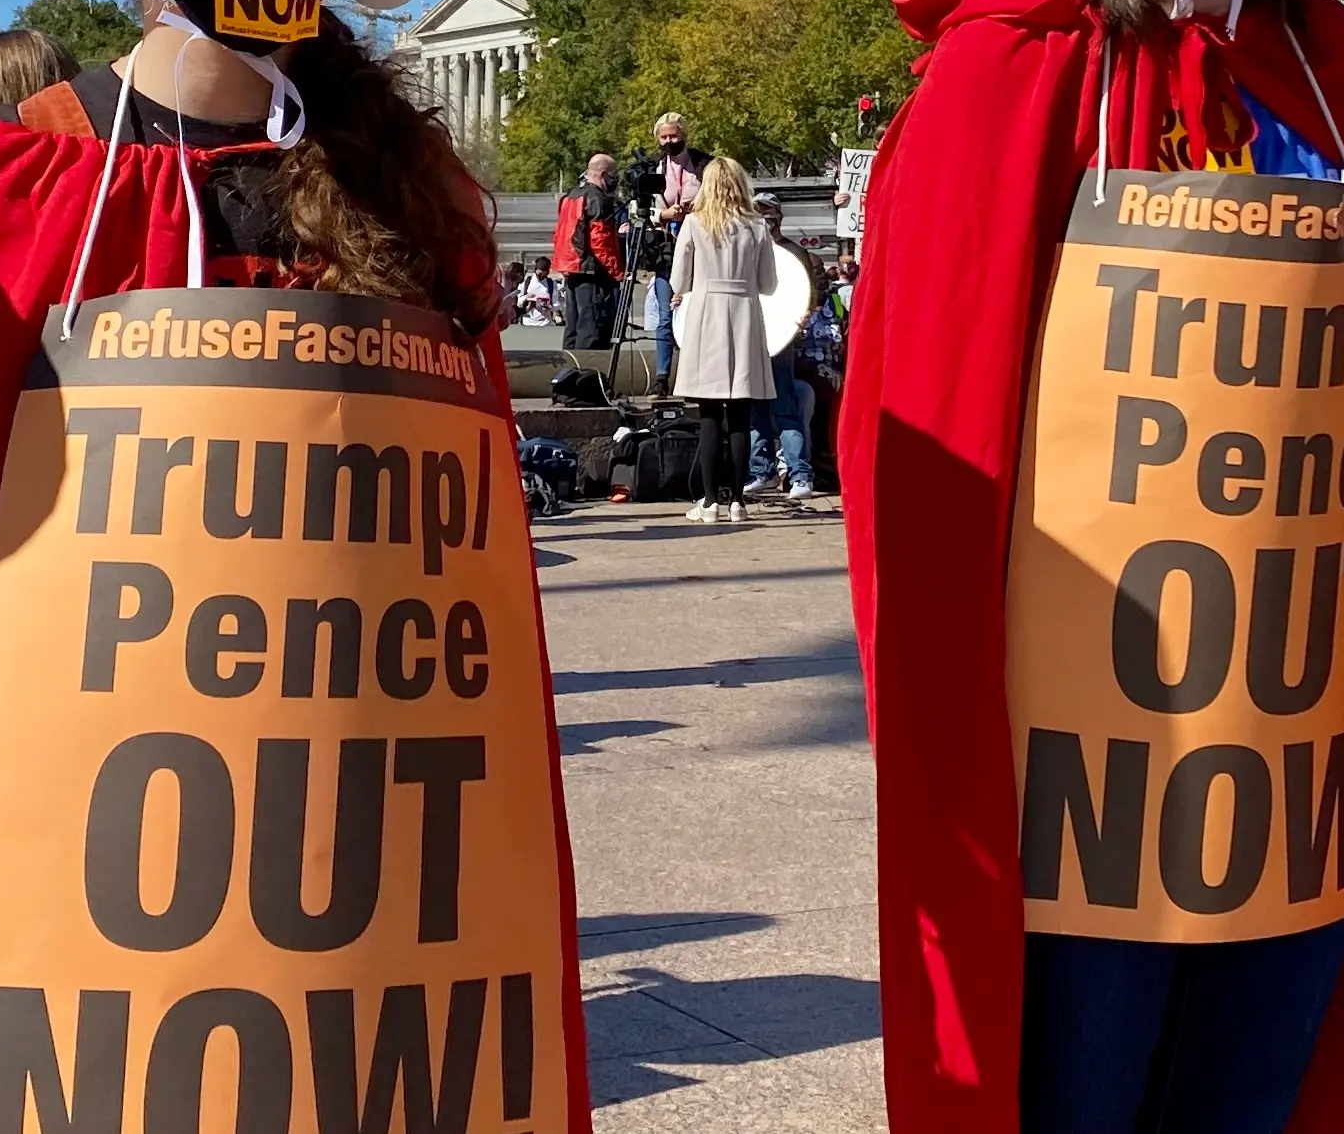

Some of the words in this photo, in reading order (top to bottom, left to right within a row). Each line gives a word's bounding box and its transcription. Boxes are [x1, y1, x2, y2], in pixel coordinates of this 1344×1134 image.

[89, 309, 477, 396] RefuseFascism.org
[64, 406, 492, 577] Trump/
[79, 559, 490, 702] Pence
[83, 730, 488, 954] OUT
